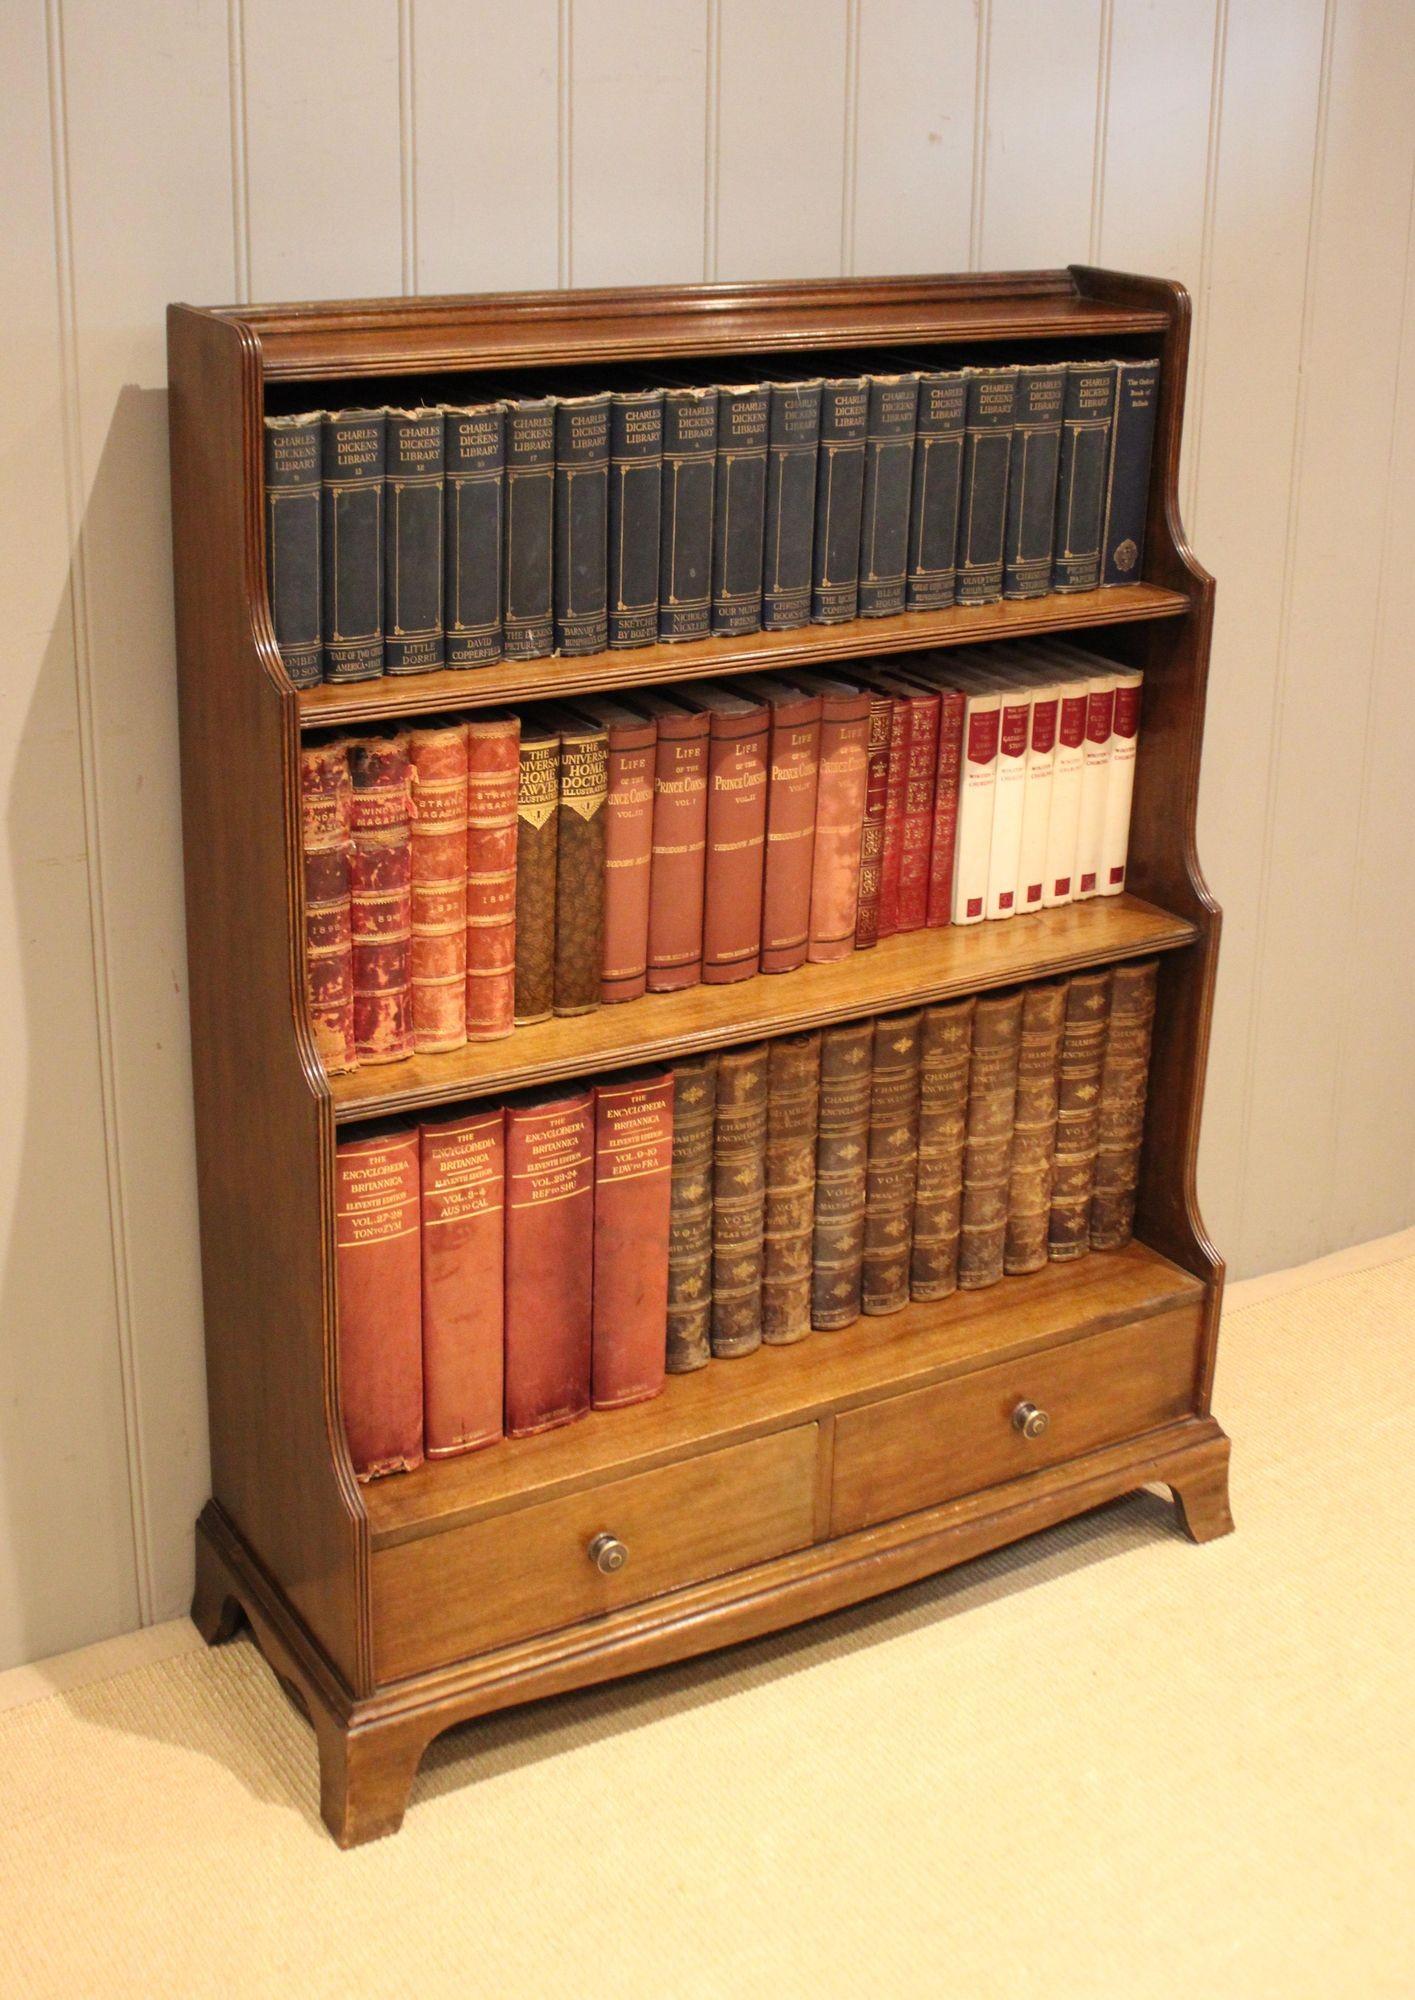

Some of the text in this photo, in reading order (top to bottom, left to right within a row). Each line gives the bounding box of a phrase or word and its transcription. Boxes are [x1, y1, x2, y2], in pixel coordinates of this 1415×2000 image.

[679, 405, 715, 417] CHARLES
[733, 402, 768, 413] CHARLES
[572, 414, 607, 426] CHARLES
[626, 409, 661, 421] CHARLES
[733, 412, 767, 424] DICKENS
[459, 422, 499, 434] CHARLES
[513, 418, 553, 429] CHARLES
[626, 420, 661, 432] DICKENS
[679, 417, 715, 428] DICKENS
[337, 429, 379, 441] CHARLES
[400, 426, 440, 438] CHARLES
[514, 429, 553, 440] DICKENS
[573, 425, 607, 437] DICKENS
[679, 428, 714, 440] LIBRARY
[733, 423, 767, 435] LIBRARY
[401, 438, 440, 450] DICKENS
[460, 434, 499, 446] DICKENS
[573, 436, 607, 449] LIBRARY
[626, 432, 661, 444] LIBRARY
[338, 441, 379, 453] DICKENS
[460, 445, 499, 458] LIBRARY
[515, 440, 553, 452] LIBRARY
[338, 453, 378, 465] LIBRARY
[400, 449, 440, 461] LIBRARY
[404, 642, 436, 654] LITTLE
[467, 638, 493, 648] DAVID
[402, 652, 438, 665] DORRIT
[792, 733, 812, 745] LIFE
[579, 742, 600, 753] THE
[676, 747, 700, 759] LIFE
[736, 744, 758, 756] LIFE
[530, 749, 550, 760] THE
[569, 761, 605, 776] HOME
[620, 759, 645, 770] LIFE
[676, 766, 685, 774] OF
[519, 768, 556, 784] HOME
[715, 775, 743, 791] PRINCE
[631, 1094, 647, 1103] THE
[550, 1117, 566, 1127] THE
[457, 1133, 474, 1142] THE
[369, 1155, 386, 1164] THE
[441, 1204, 460, 1217] AUS
